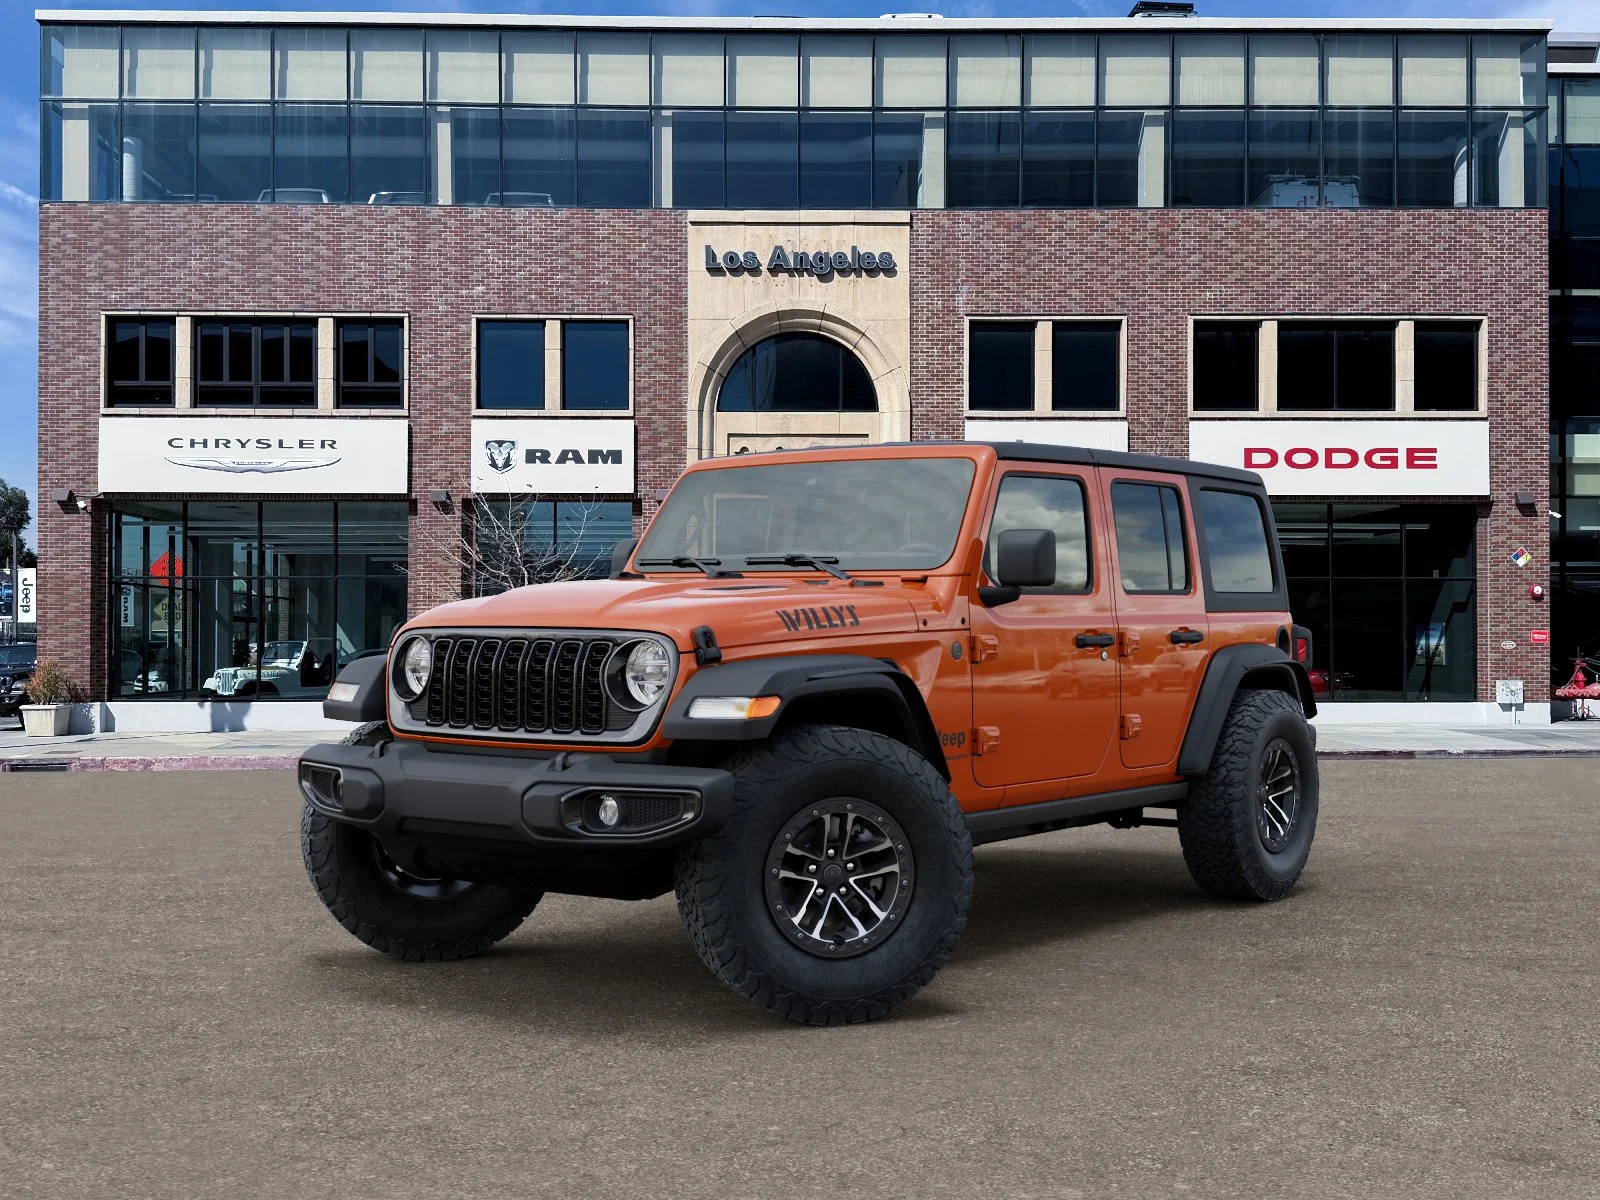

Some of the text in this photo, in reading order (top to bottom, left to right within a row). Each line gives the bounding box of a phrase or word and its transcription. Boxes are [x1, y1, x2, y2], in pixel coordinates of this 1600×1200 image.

[704, 244, 895, 275] Los Angeles
[167, 437, 338, 450] CHRYSLER
[524, 448, 623, 465] RAM
[1243, 447, 1438, 470] DODGE
[20, 577, 34, 614] Jeep
[161, 602, 183, 611] DAD
[164, 612, 181, 620] ED
[774, 604, 861, 632] WILLYS
